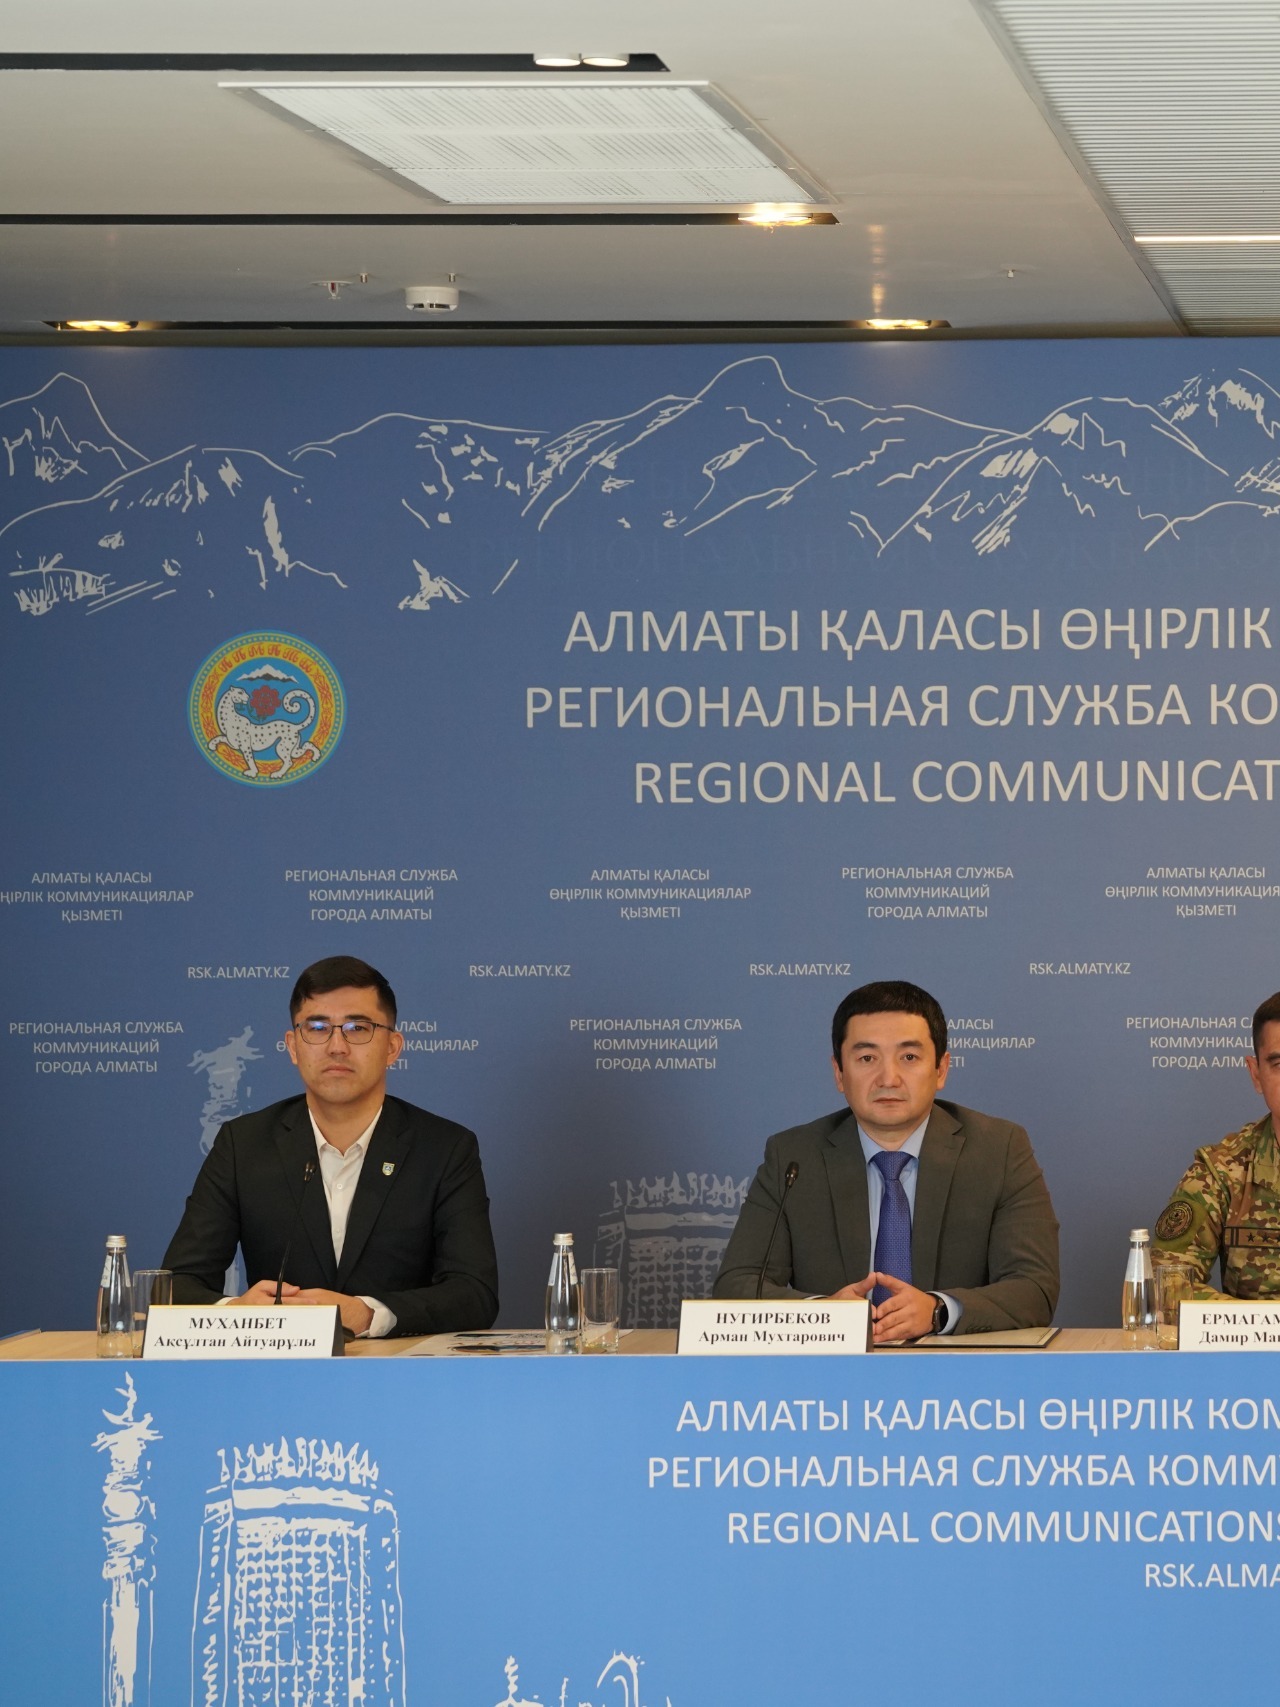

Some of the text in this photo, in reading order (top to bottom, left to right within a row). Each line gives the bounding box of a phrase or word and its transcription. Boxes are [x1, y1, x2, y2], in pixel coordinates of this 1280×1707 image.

[563, 609, 799, 653] АЛМАТЫ
[821, 608, 1040, 661] ҚАЛАСЫ
[1060, 607, 1272, 660] ӨҢІРЛІК
[526, 685, 948, 729] РЕГИОНАЛЬНАЯ
[968, 683, 1192, 727] СЛУЖБА
[635, 761, 897, 804] REGIONAL
[31, 871, 152, 886] АЛМАТЫ ҚАЛАСЫ
[285, 869, 459, 882] РЕГИОНАЛЬНАЯ СЛУЖБА
[590, 868, 710, 883] АЛМАТЫ ҚАЛАСЫ
[841, 866, 1014, 880] РЕГИОНАЛЬНАЯ СЛУЖБА
[1146, 866, 1266, 881] АЛМАТЫ ҚАЛАСЫ
[0, 890, 195, 905] ҢІРЛІК КОММУНИКАЦИЯЛАР
[308, 885, 434, 904] КОММУНИКАЦИЙ
[549, 887, 752, 903] ӨҢІРЛІК КОММУНИКАЦИЯЛАР
[865, 883, 990, 901] КОММУНИКАЦИЙ
[1104, 885, 1159, 900] ӨҢІРЛІК
[61, 909, 123, 924] ҚЫЗМЕТІ
[311, 908, 432, 924] ГОРОДА АЛМАТЫ
[620, 906, 681, 921] ҚЫЗМЕТІ
[867, 905, 988, 921] ГОРОДА АЛМАТЫ
[1176, 904, 1237, 919] ҚЫЗМЕТІ
[187, 966, 290, 979] RSK.ALMATY.KZ
[469, 964, 571, 978] RSK.ALMATY.KZ
[749, 963, 852, 976] RSK.ALMATY.KZ
[1029, 962, 1132, 975] RSK.ALMATY.KZ
[9, 1021, 184, 1035] РЕГИОНАЛЬНАЯ СЛУЖБА
[394, 1020, 438, 1033] ЛАСЫ
[569, 1018, 743, 1031] РЕГИОНАЛЬНАЯ СЛУЖБА
[946, 1018, 994, 1031] АЛАСЫ
[1126, 1016, 1237, 1029] РЕГИОНАЛЬНАЯ
[33, 1038, 160, 1056] КОММУНИКАЦИЙ
[403, 1039, 480, 1054] КАЦИЯЛАР
[593, 1035, 718, 1053] КОММУНИКАЦИЙ
[947, 1037, 1036, 1051] НИКАЦИЯЛАР
[1149, 1036, 1254, 1050] КОММУНИКАЦ
[35, 1060, 158, 1076] ГОРОДА АЛМАТЫ
[595, 1057, 717, 1072] ГОРОДА АЛМАТЫ
[1152, 1055, 1250, 1070] ГОРОДА АЛМ
[188, 1317, 286, 1330] МУХАНБЕТ
[716, 1312, 831, 1325] НУГИРБЕКОВ
[154, 1335, 317, 1350] Ақсұлтан Айтуарұлы
[698, 1330, 846, 1346] Арман Мухтарович
[1199, 1331, 1249, 1346] Дамир
[676, 1399, 848, 1432] АЛМАТЫ
[864, 1398, 1025, 1439] ҚАЛАСЫ
[1039, 1398, 1195, 1438] ӨҢІРЛІК
[648, 1455, 958, 1489] РЕГИОНАЛЬНАЯ
[972, 1454, 1136, 1487] СЛУЖБА
[728, 1511, 920, 1544] REGIONAL
